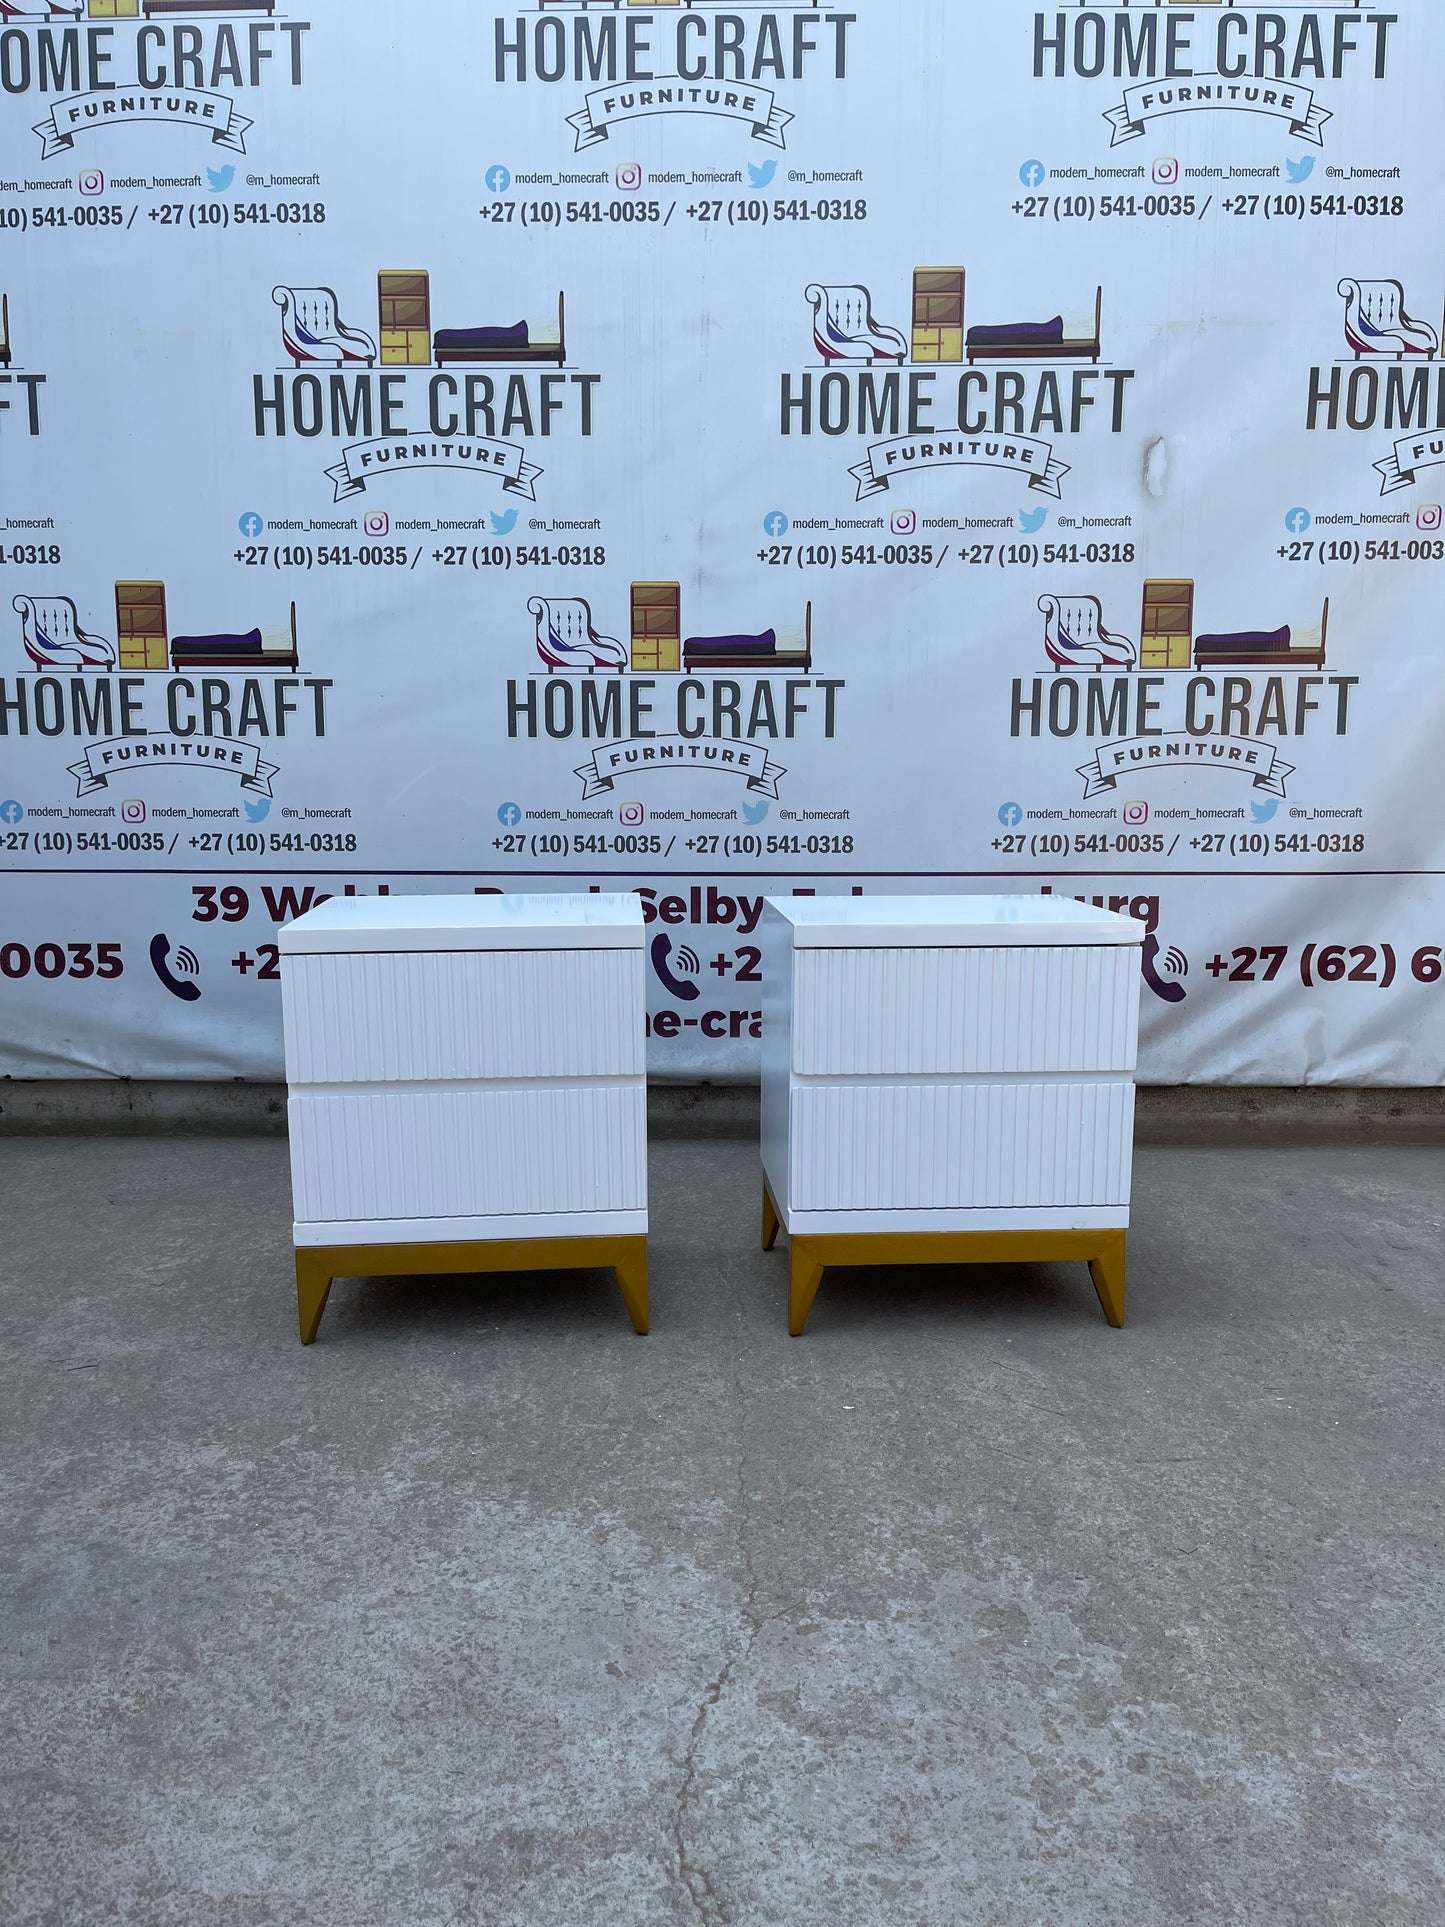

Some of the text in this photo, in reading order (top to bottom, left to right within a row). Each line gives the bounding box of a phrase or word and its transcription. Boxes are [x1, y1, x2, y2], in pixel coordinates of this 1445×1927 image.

[136, 20, 310, 90] CRAFT
[495, 14, 856, 83] HOME CRAFT
[1034, 12, 1398, 80] HOME CRAFT
[67, 96, 215, 123] FURNITURE
[603, 88, 755, 115] FURNITURE
[1141, 84, 1297, 112] FURNITURE
[111, 175, 201, 189] modern_homecraft
[246, 174, 320, 187] @m_homecraft
[516, 170, 862, 185] modern_homecraft modern_homecraft @m_homecraft
[1050, 166, 1400, 180] modern_homecraft modern_homecraft @m_homecraft
[253, 374, 601, 438] HOME CRAFT
[781, 370, 1134, 437] HOME CRAFT
[360, 443, 508, 468] FURNITURE
[884, 441, 1033, 468] FURNITURE
[268, 519, 600, 531] modern_homecraft modern_homecraft @m_homecraft
[793, 515, 1131, 530] modern_homecraft modern_homecraft @m_homecraft
[1316, 512, 1409, 525] modern_homecraft
[0, 677, 333, 737] HOME CRAFT
[507, 679, 845, 740] HOME CRAFT
[1011, 677, 1359, 738] HOME CRAFT
[101, 742, 244, 766] FURNITURE
[608, 744, 753, 768] FURNITURE
[1113, 742, 1259, 766] FURNITURE
[28, 807, 351, 819] modern_homecraft modern_homecraft @m_homecraft
[526, 809, 849, 821] modern_homecraft modern_homecraft @m_homecraft
[1027, 808, 1362, 820] modern_homecraft modern_homecraft @m_homecraft
[192, 886, 249, 922] 39
[0, 943, 124, 979] 0035
[1205, 946, 1288, 982] +27
[1300, 944, 1396, 988] (62)
